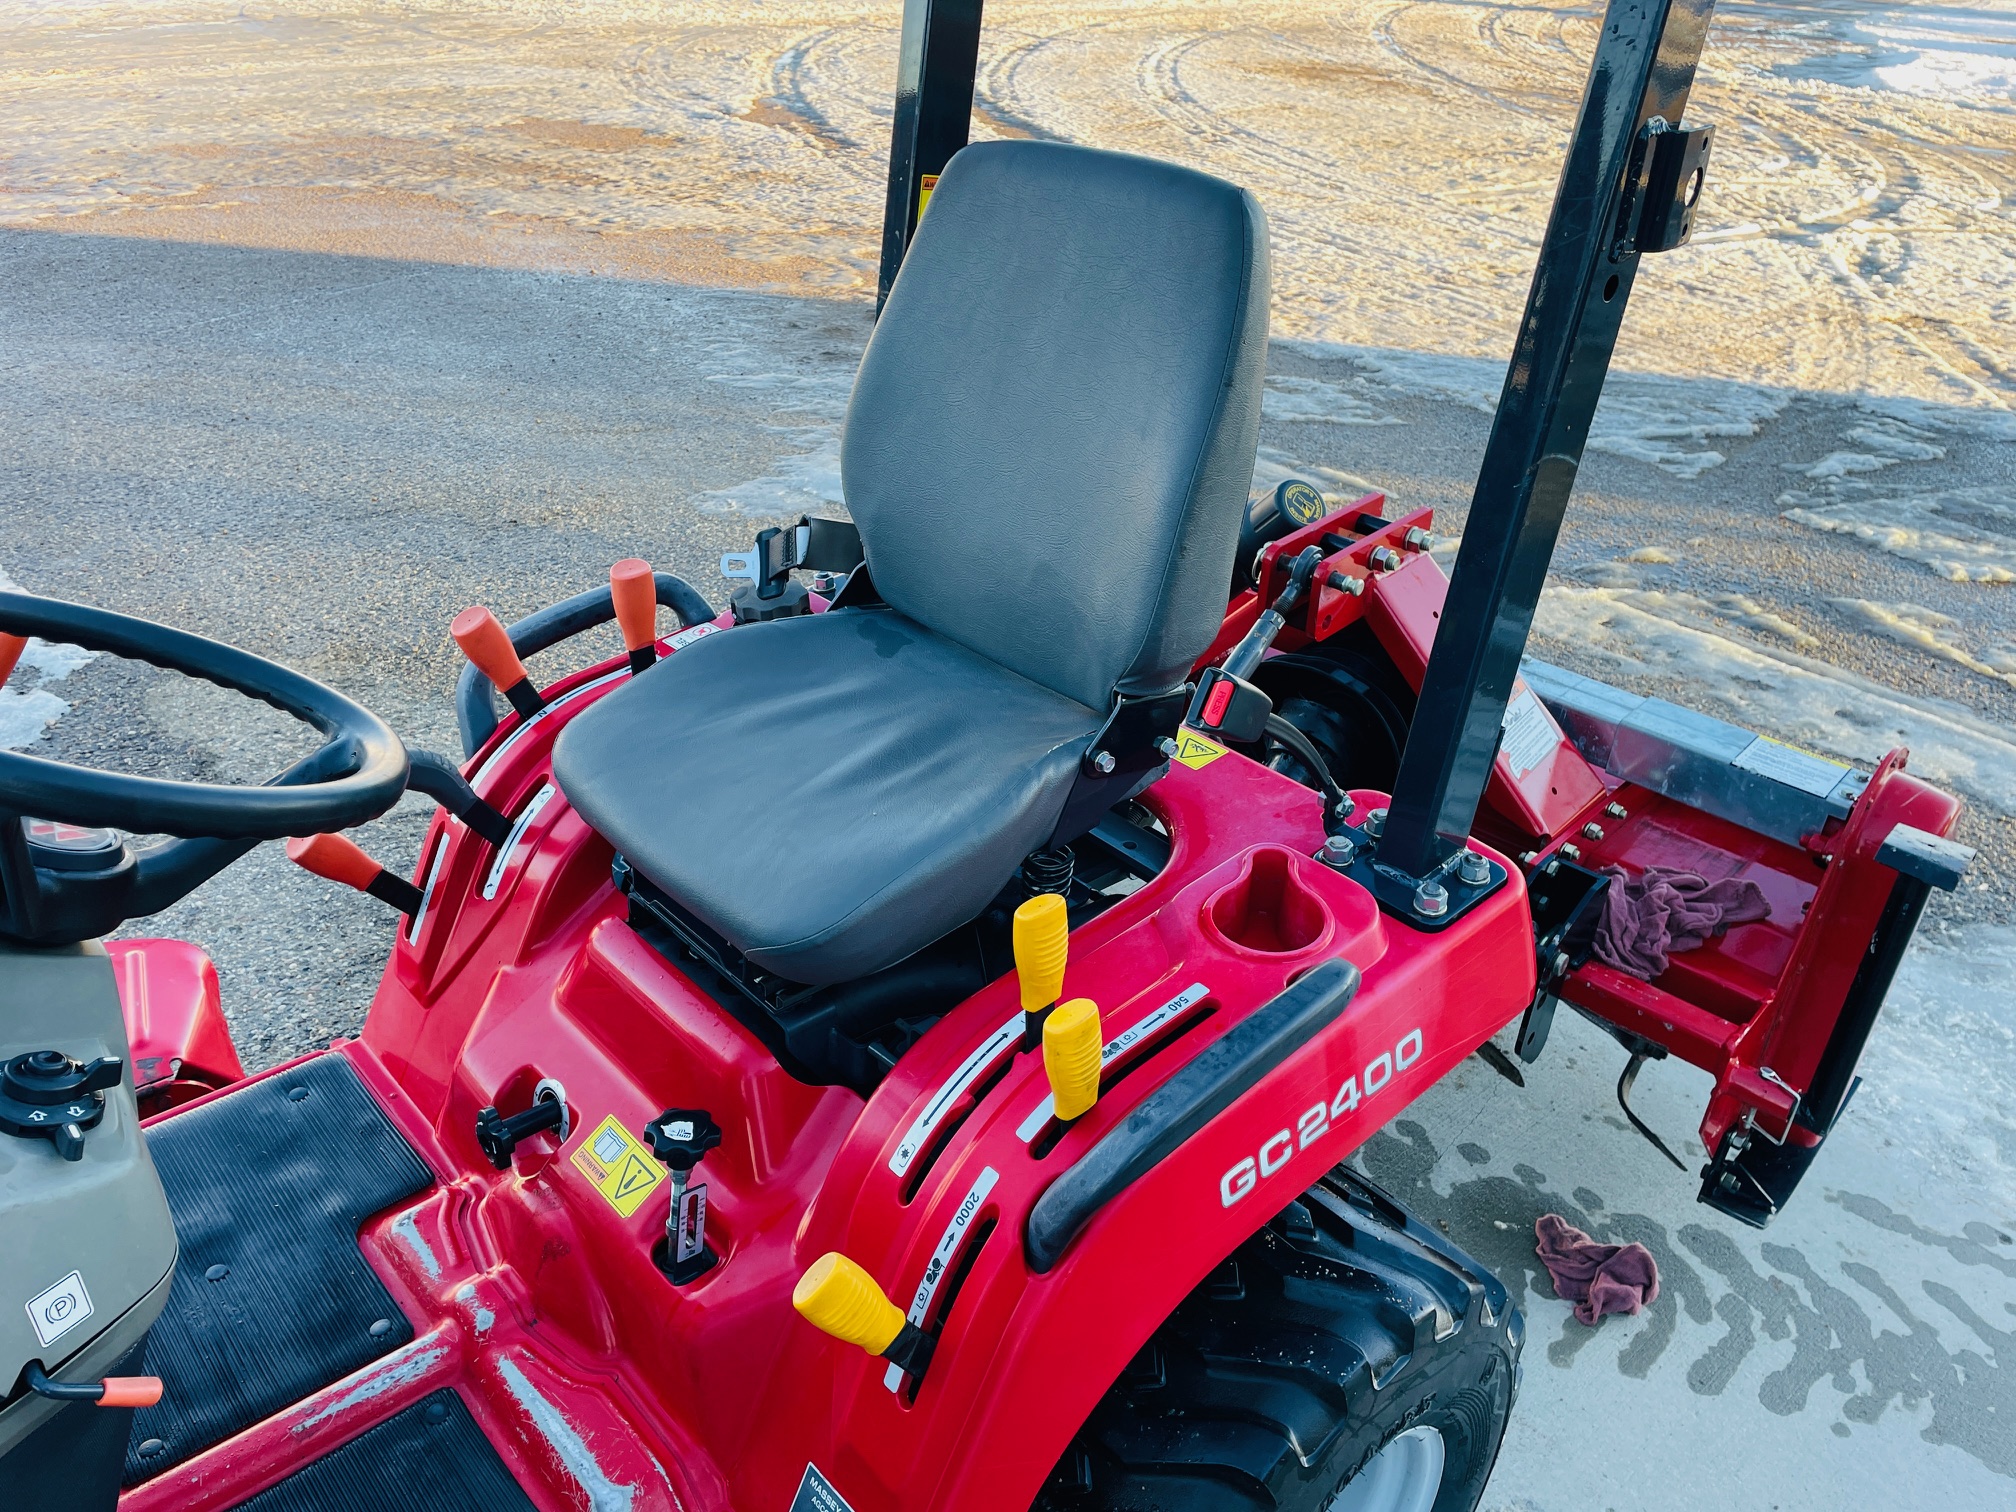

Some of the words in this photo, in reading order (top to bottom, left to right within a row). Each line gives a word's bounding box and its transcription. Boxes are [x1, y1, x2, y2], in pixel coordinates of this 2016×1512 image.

[1211, 691, 1227, 715] PRESS
[1168, 996, 1189, 1012] 540
[1220, 1028, 1423, 1209] GC2400
[578, 1150, 602, 1179] WARNING
[955, 1191, 980, 1226] 2000
[54, 1299, 67, 1317] P
[809, 1476, 842, 1512] MASSEY
